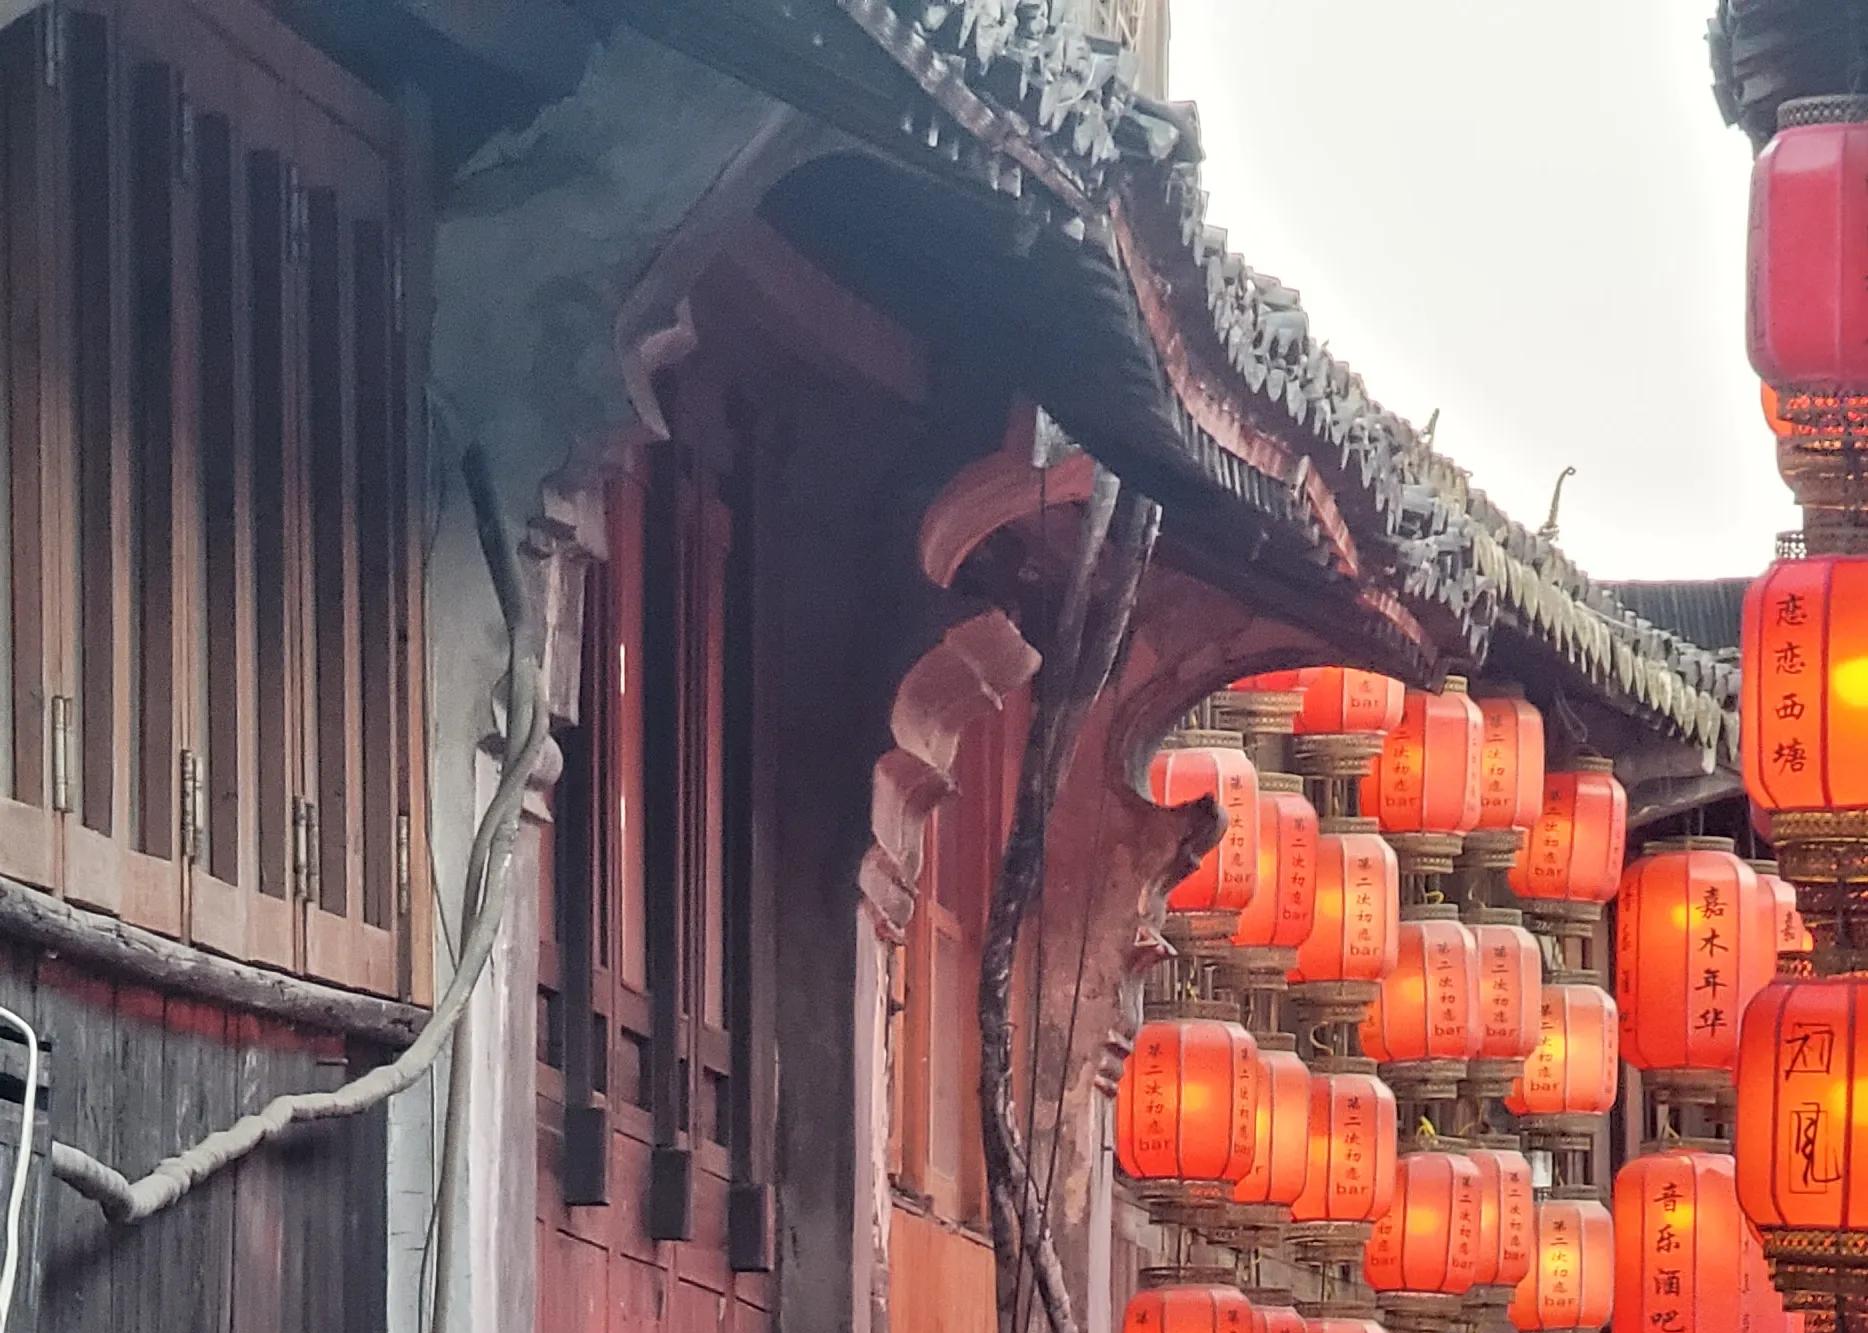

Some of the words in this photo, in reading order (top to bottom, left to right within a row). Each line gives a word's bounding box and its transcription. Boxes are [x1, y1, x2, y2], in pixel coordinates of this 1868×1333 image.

[1772, 593, 1808, 776] 恋恋西塘
[1351, 696, 1380, 708] bar
[1385, 795, 1416, 808] bar
[1224, 871, 1251, 884] bar
[1534, 866, 1563, 878] bar
[1282, 908, 1309, 921] bar
[1350, 944, 1380, 957] bar
[1694, 885, 1729, 1038] 嘉木年华
[1434, 1024, 1465, 1037] bar
[1486, 1024, 1518, 1037] bar
[1530, 1080, 1561, 1092] bar
[1138, 1138, 1171, 1152] bar
[1336, 1182, 1369, 1195] bar
[1370, 1254, 1397, 1266] bar
[1650, 1181, 1687, 1333] 音乐酒吧
[1544, 1295, 1575, 1307] bar
